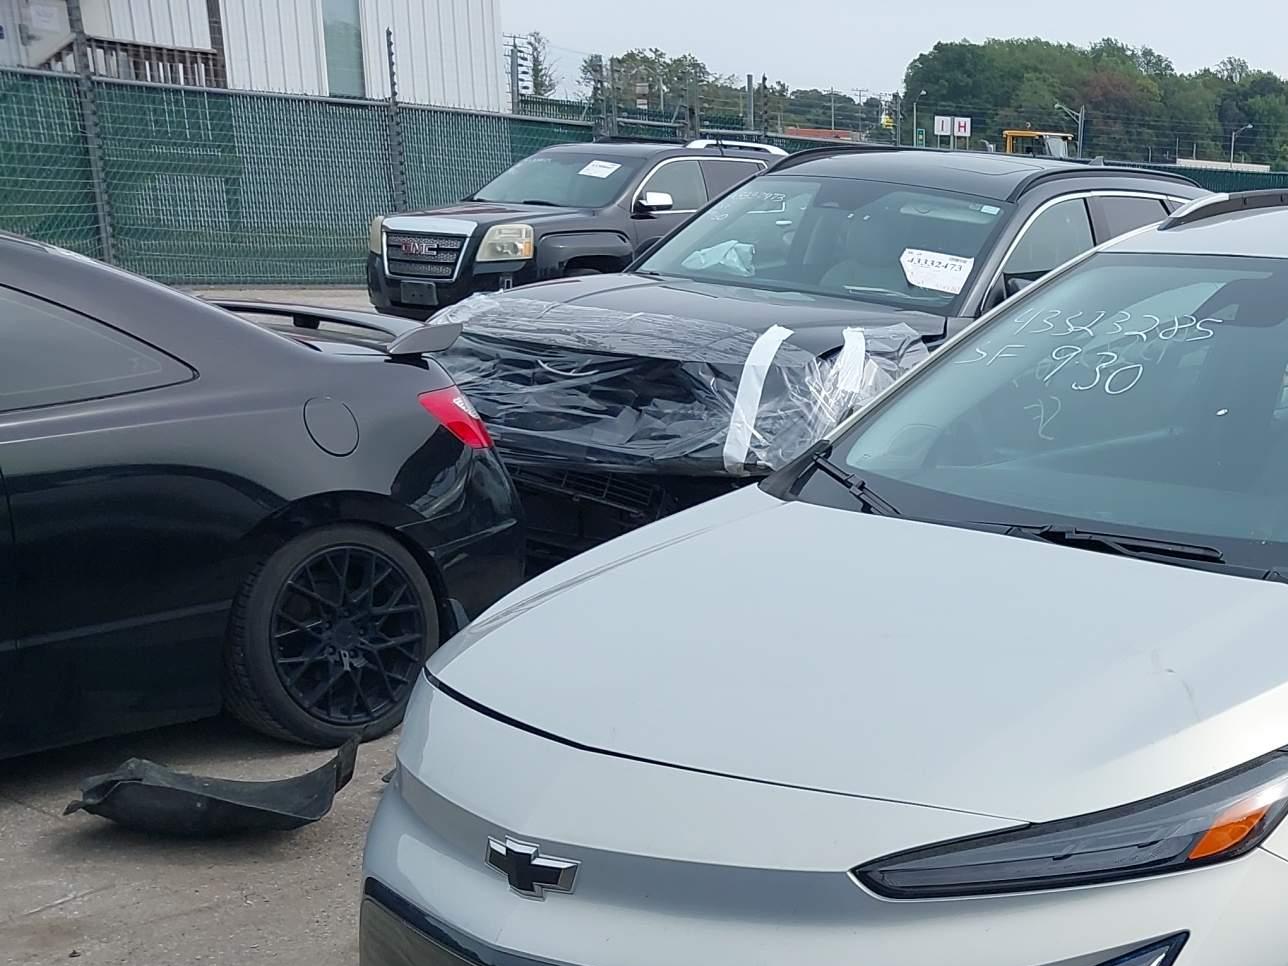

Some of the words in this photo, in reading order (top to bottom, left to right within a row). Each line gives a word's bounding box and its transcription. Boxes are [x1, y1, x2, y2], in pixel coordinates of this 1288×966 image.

[958, 120, 967, 133] H
[402, 241, 438, 256] GMC
[954, 340, 1026, 367] SF
